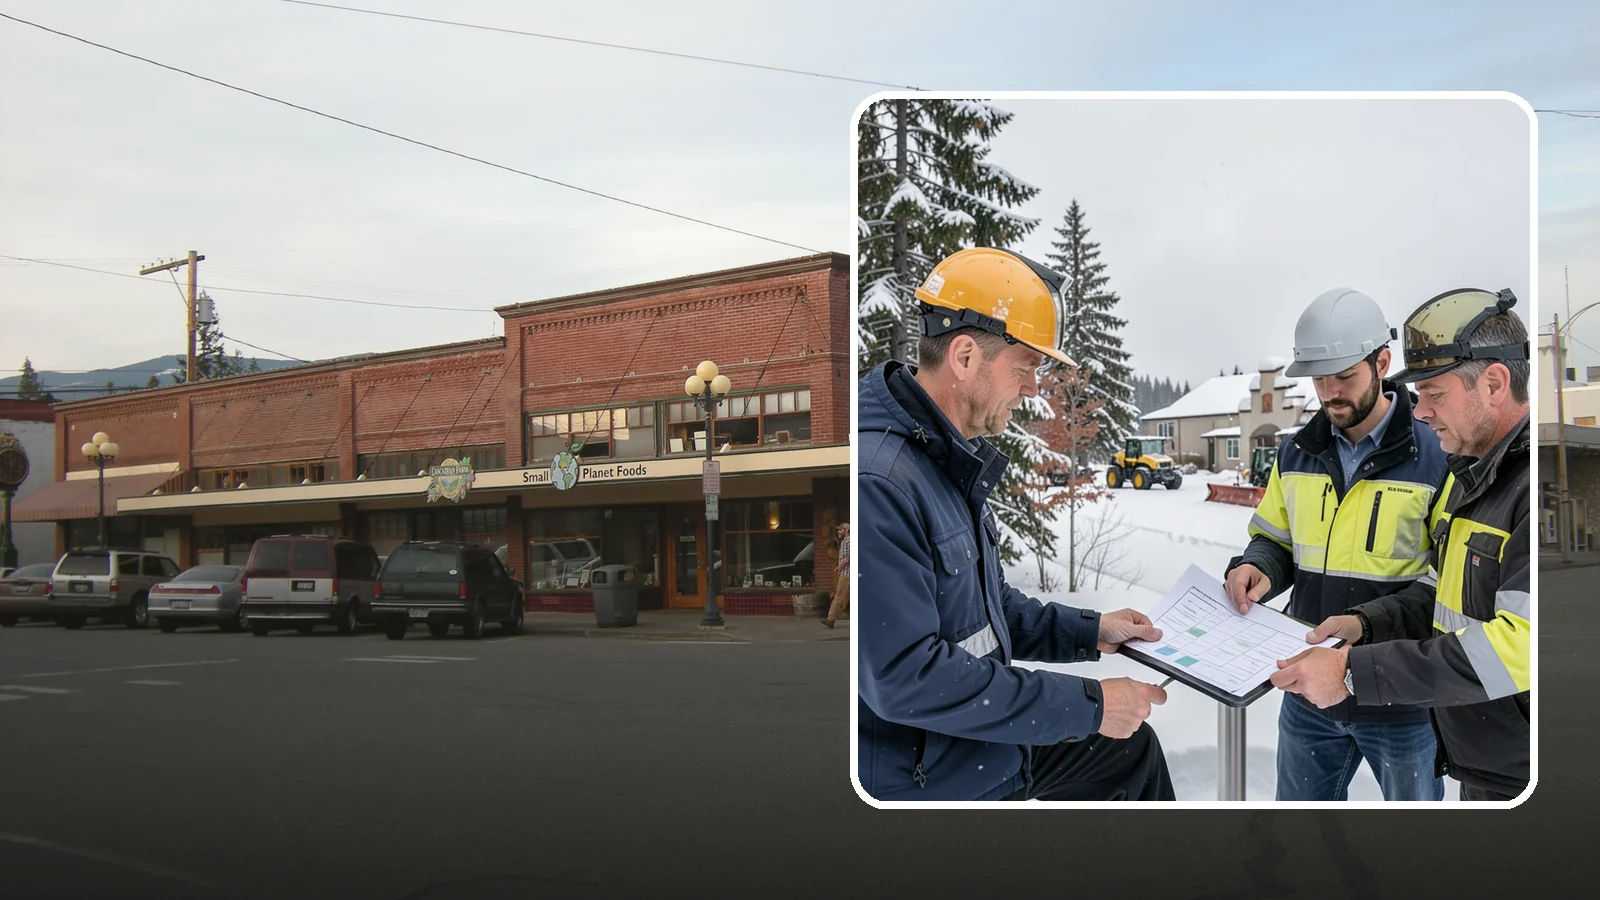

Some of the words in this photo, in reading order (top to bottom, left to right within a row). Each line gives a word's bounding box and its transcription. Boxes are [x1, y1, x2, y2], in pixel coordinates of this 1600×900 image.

[523, 471, 549, 483] Small
[583, 467, 614, 479] Planet
[617, 464, 647, 477] Foods
